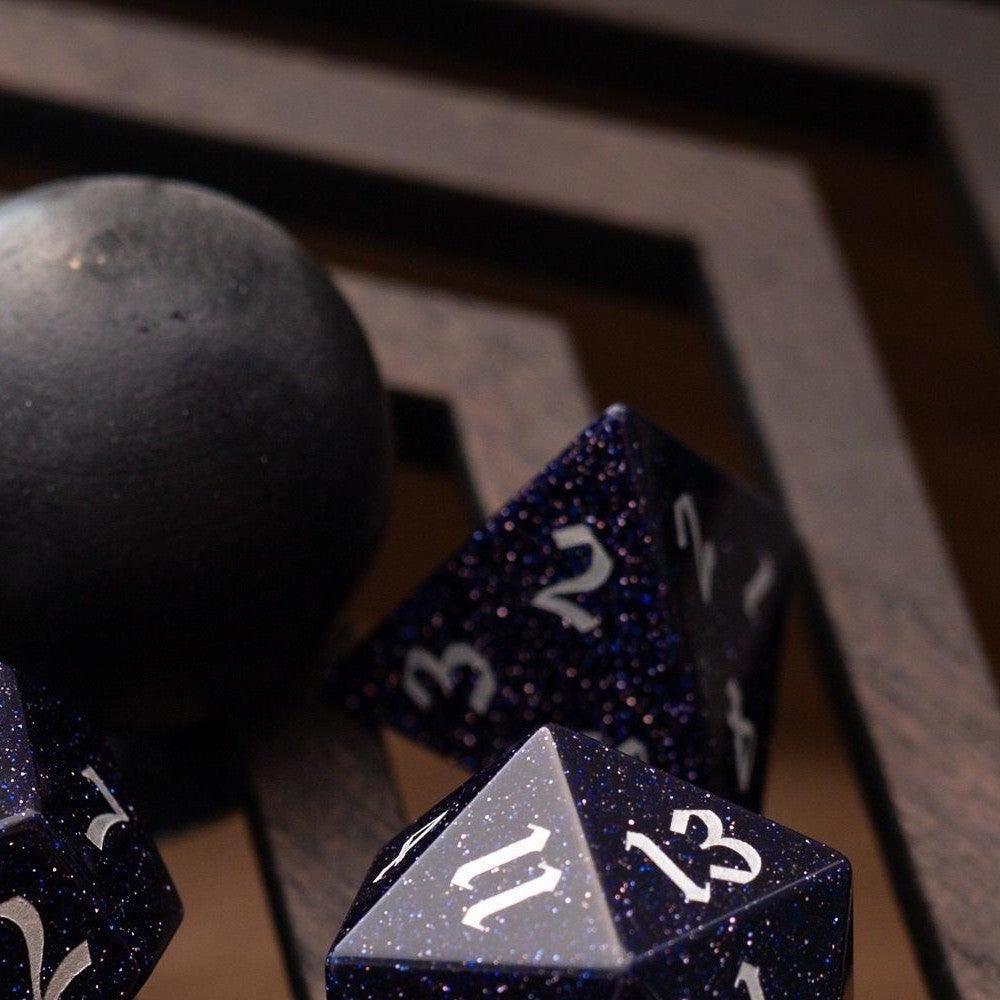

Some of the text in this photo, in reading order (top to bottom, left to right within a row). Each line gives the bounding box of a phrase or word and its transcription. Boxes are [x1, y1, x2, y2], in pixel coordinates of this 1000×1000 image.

[531, 523, 614, 633] 2
[404, 642, 496, 716] 3
[450, 822, 564, 932] 11
[624, 809, 762, 904] 13
